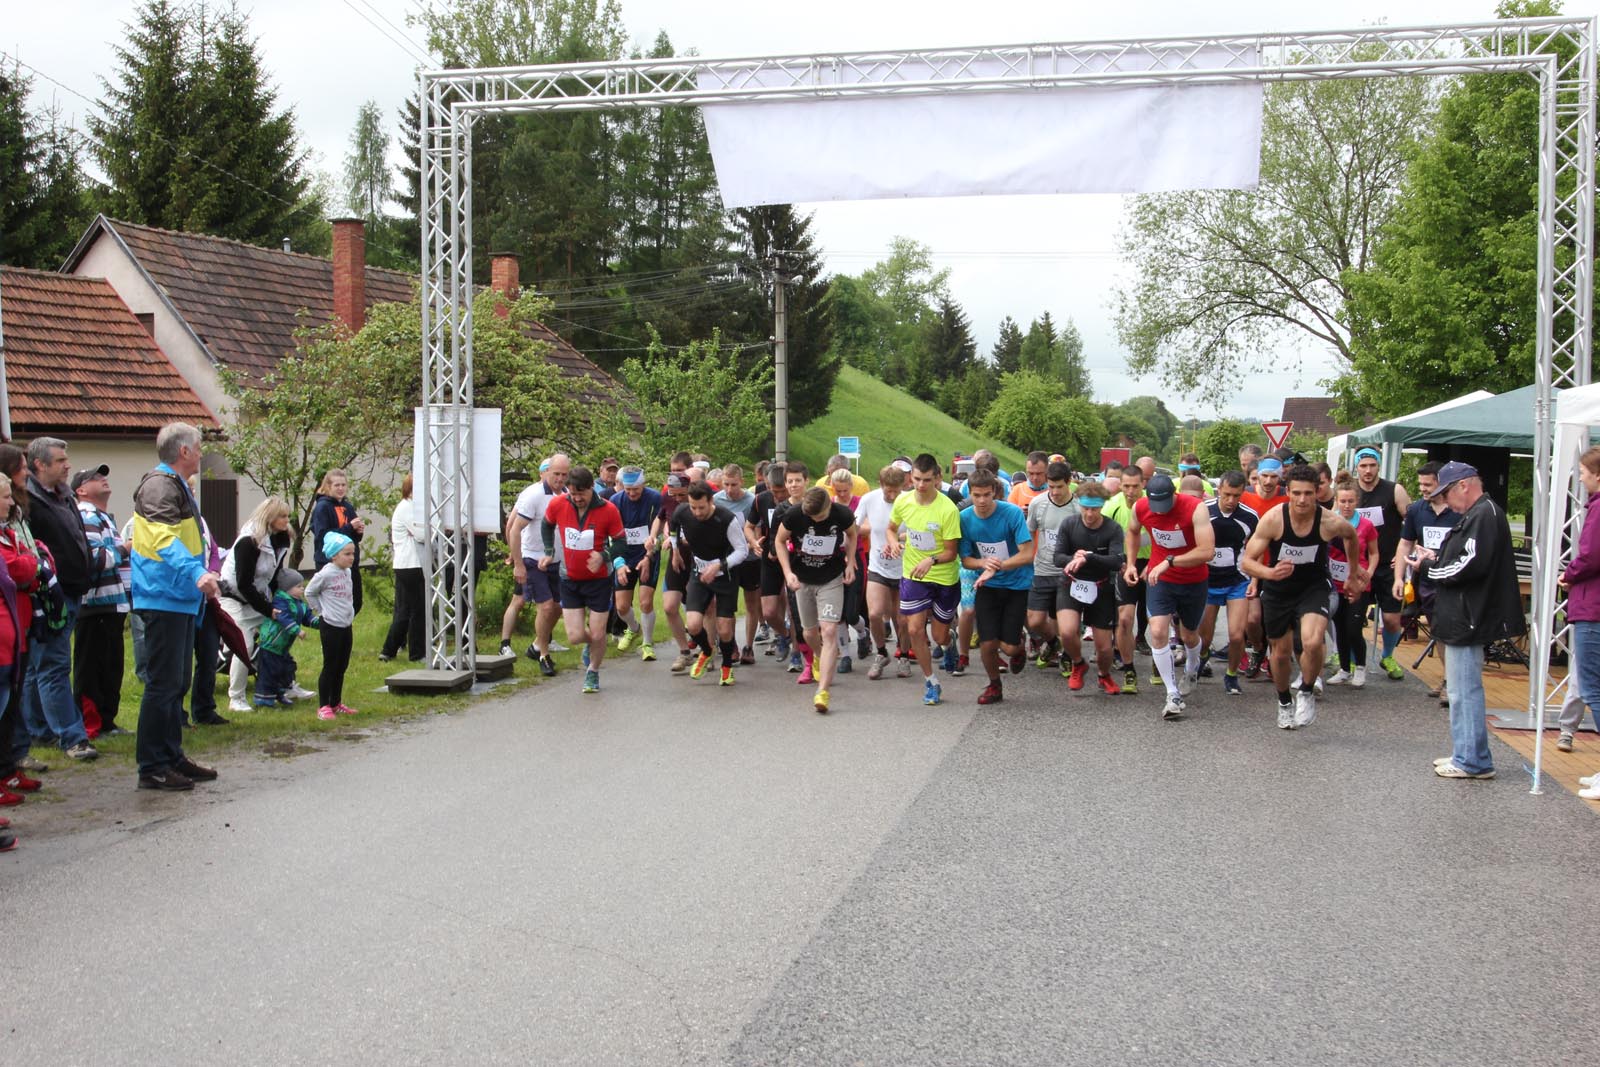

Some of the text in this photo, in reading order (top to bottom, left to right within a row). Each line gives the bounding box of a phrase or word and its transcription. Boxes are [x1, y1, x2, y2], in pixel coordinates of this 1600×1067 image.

[1156, 532, 1171, 541] 082
[1427, 530, 1441, 539] 073
[807, 538, 823, 547] 068
[981, 545, 996, 554] 062
[1285, 548, 1303, 557] 006
[1331, 563, 1345, 573] 072
[1075, 583, 1089, 593] 696
